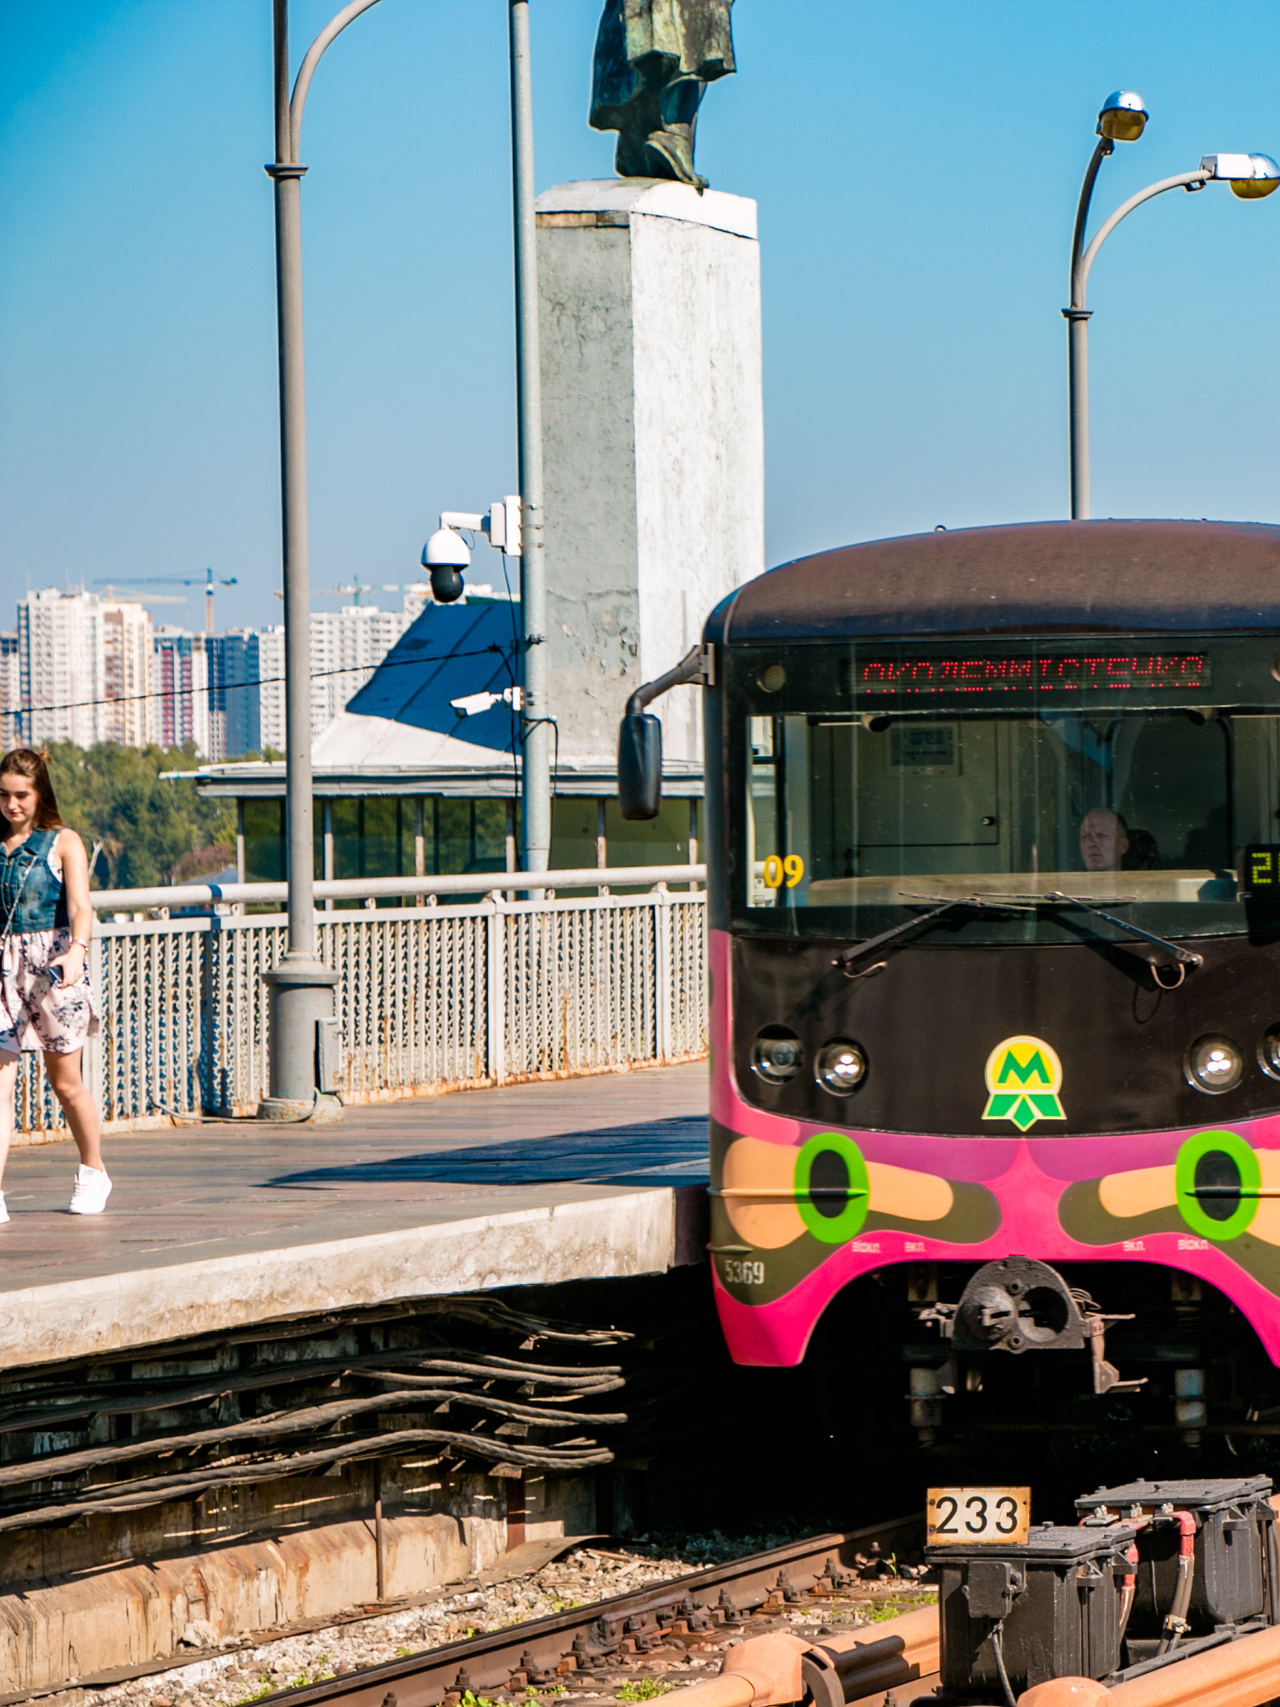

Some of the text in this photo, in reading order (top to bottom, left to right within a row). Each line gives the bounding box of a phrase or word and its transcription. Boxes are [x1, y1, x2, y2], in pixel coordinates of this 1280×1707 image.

[763, 854, 804, 888] 09
[725, 1260, 765, 1285] 5369
[936, 1496, 1018, 1534] 233
